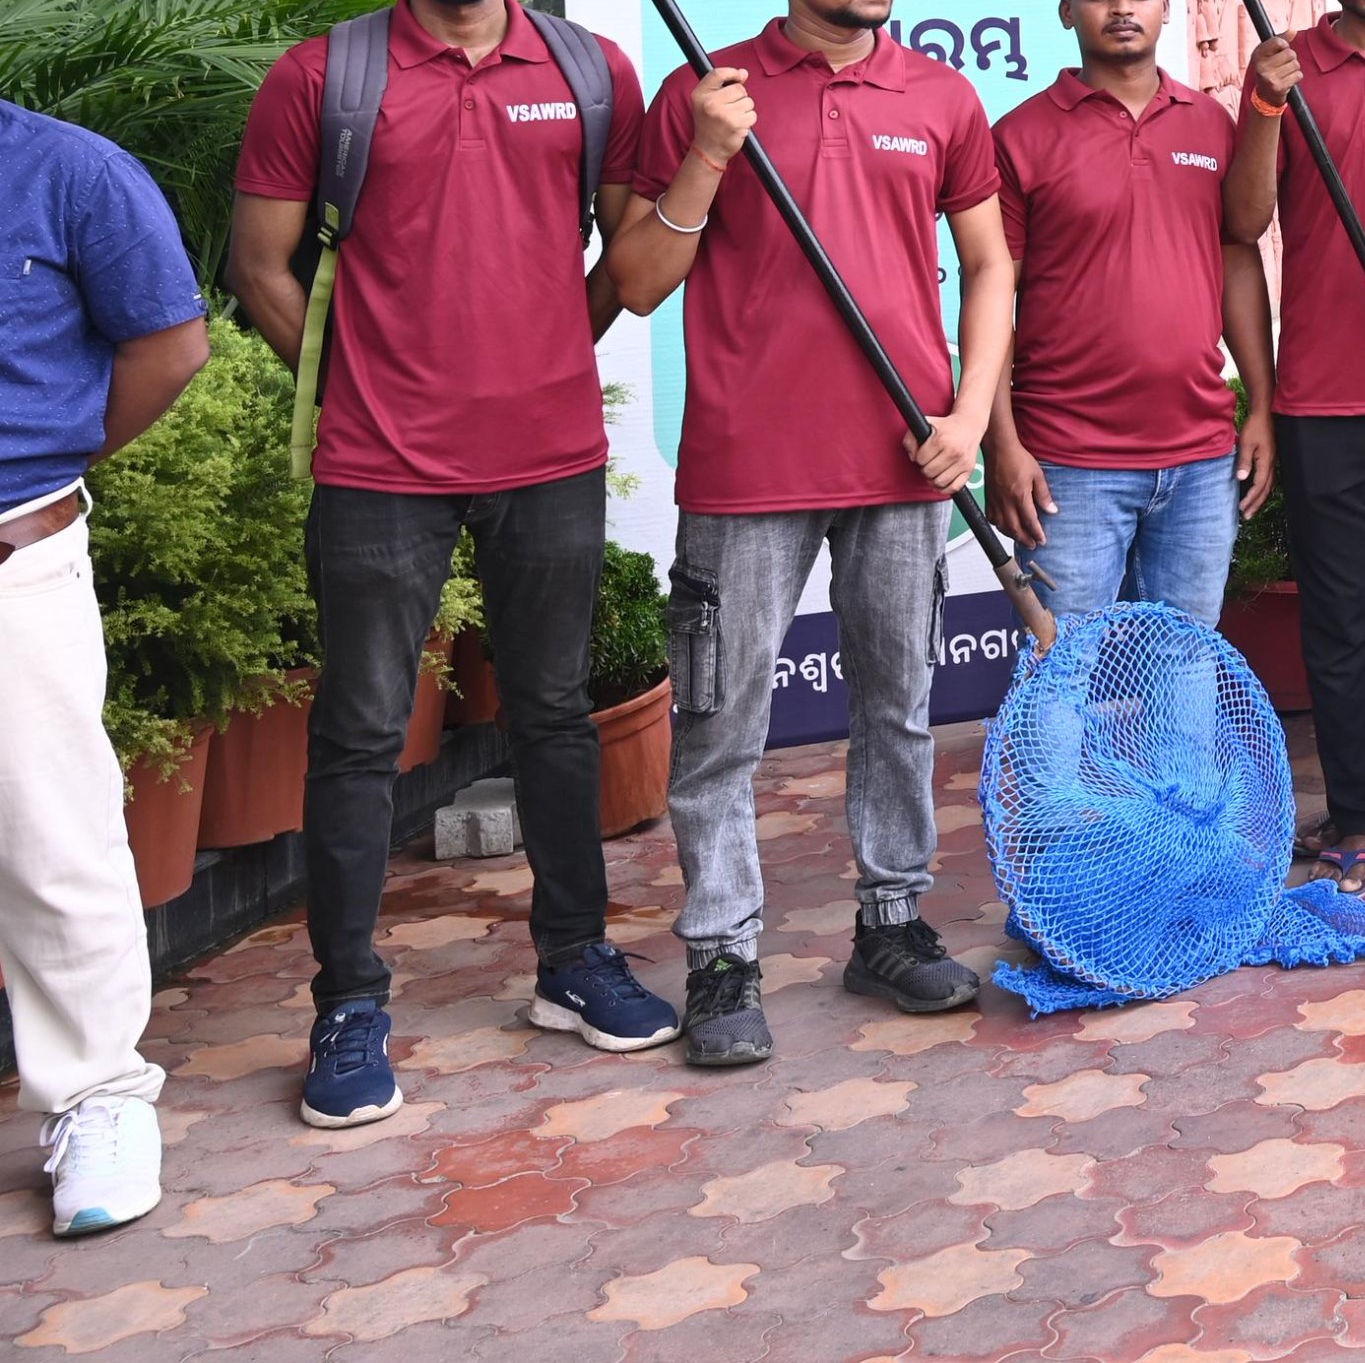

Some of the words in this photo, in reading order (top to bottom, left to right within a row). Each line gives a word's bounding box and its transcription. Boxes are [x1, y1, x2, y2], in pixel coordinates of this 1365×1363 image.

[506, 102, 577, 123] VSAWRD
[871, 134, 928, 156] VSAWRD
[1171, 151, 1218, 172] VSAWRD
